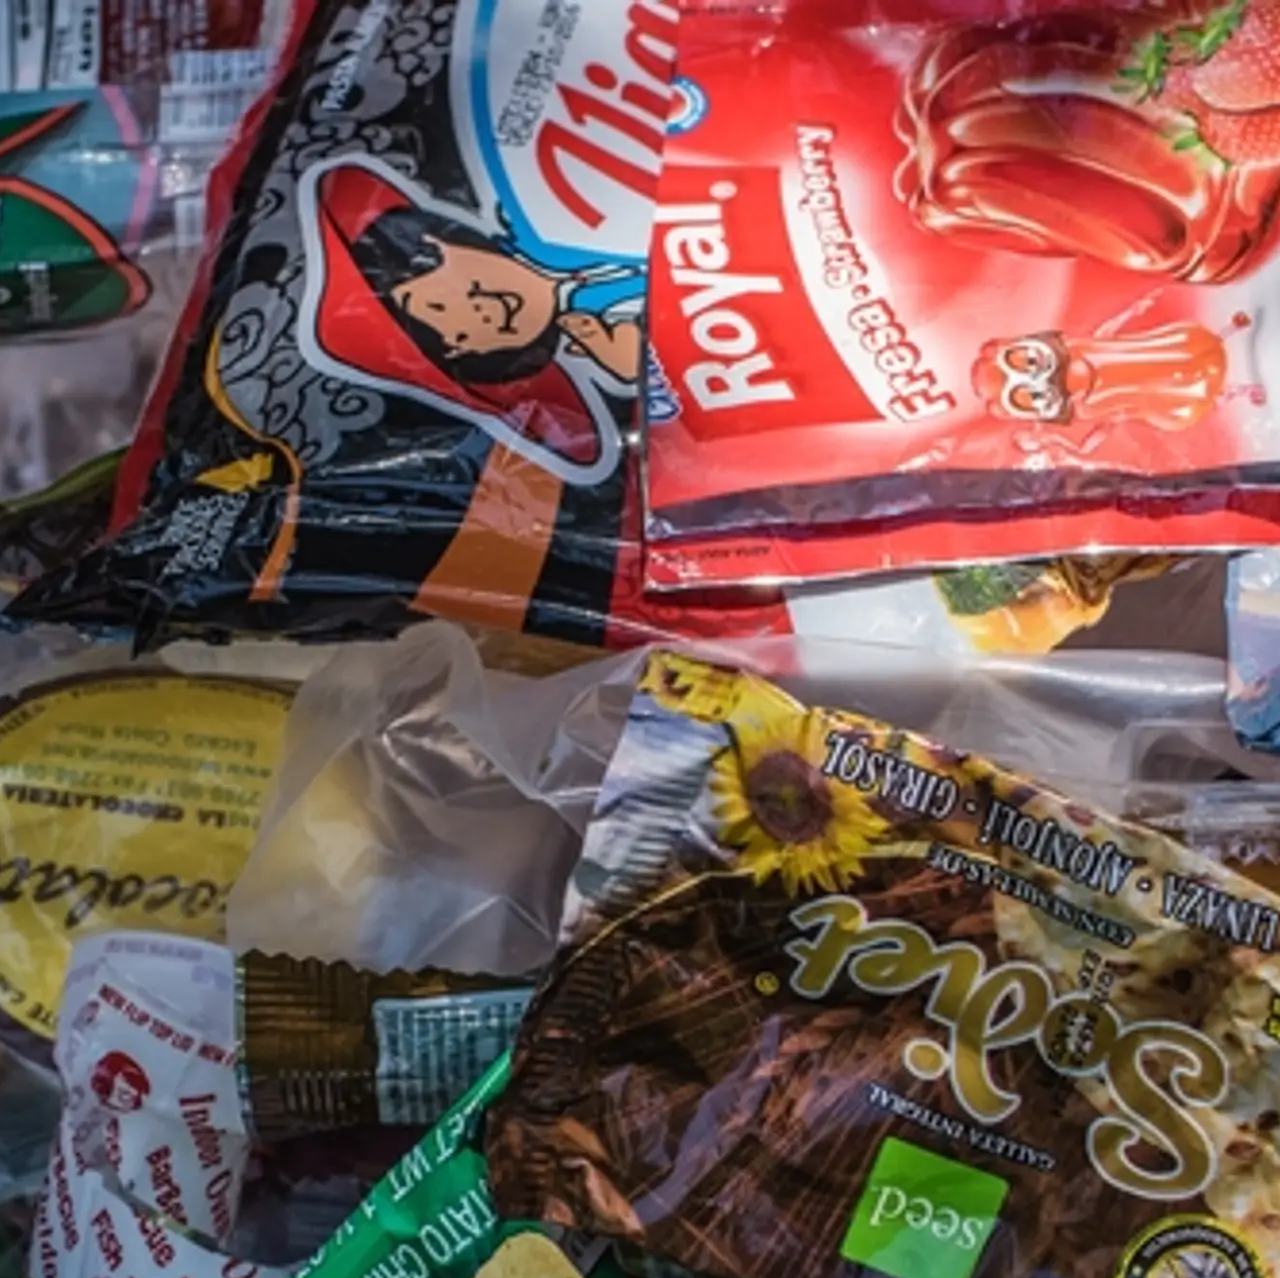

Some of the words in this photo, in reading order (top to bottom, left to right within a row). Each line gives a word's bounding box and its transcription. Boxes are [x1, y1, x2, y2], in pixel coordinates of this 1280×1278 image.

[797, 124, 868, 289] Strawberry
[848, 297, 957, 422] Fresa
[824, 733, 959, 820] GIRASOL
[979, 802, 1135, 898] AJONJOLÍ
[870, 1184, 986, 1252] seed
